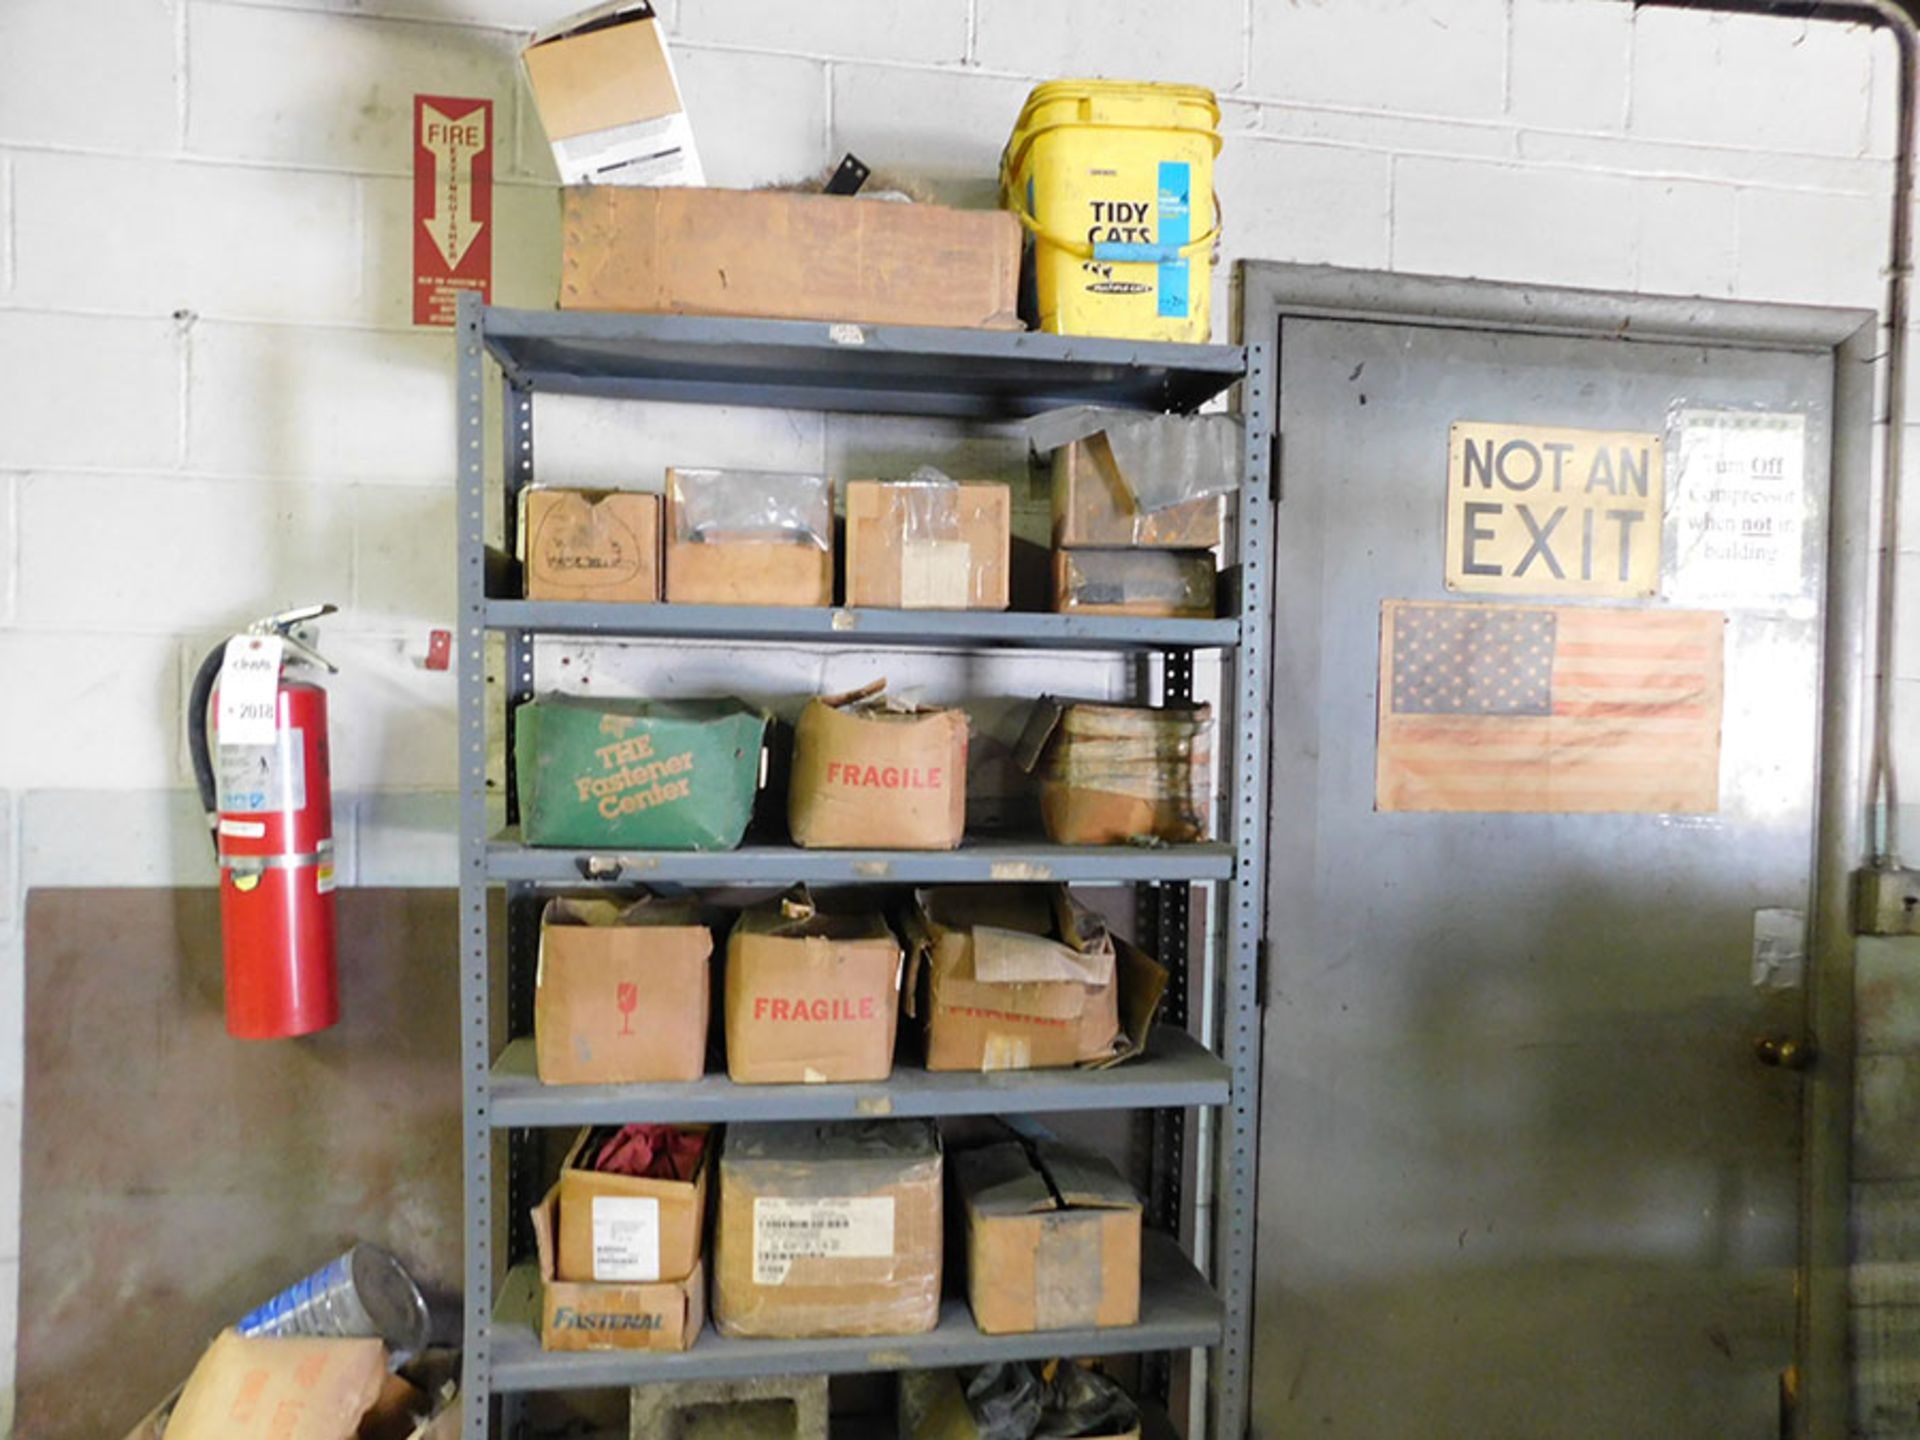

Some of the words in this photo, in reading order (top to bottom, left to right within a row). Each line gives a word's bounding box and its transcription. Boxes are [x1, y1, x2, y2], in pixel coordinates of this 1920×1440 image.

[427, 123, 479, 147] FIRE
[1089, 201, 1149, 223] TIDY
[1088, 226, 1151, 244] CATS
[1462, 438, 1574, 492] NOT
[1584, 446, 1649, 497] AN
[1741, 516, 1773, 532] not
[1461, 501, 1645, 581] EXIT
[595, 734, 654, 768] THE
[827, 762, 942, 789] FRAGILE
[598, 777, 690, 819] Center
[753, 996, 874, 1021] FRAGILE
